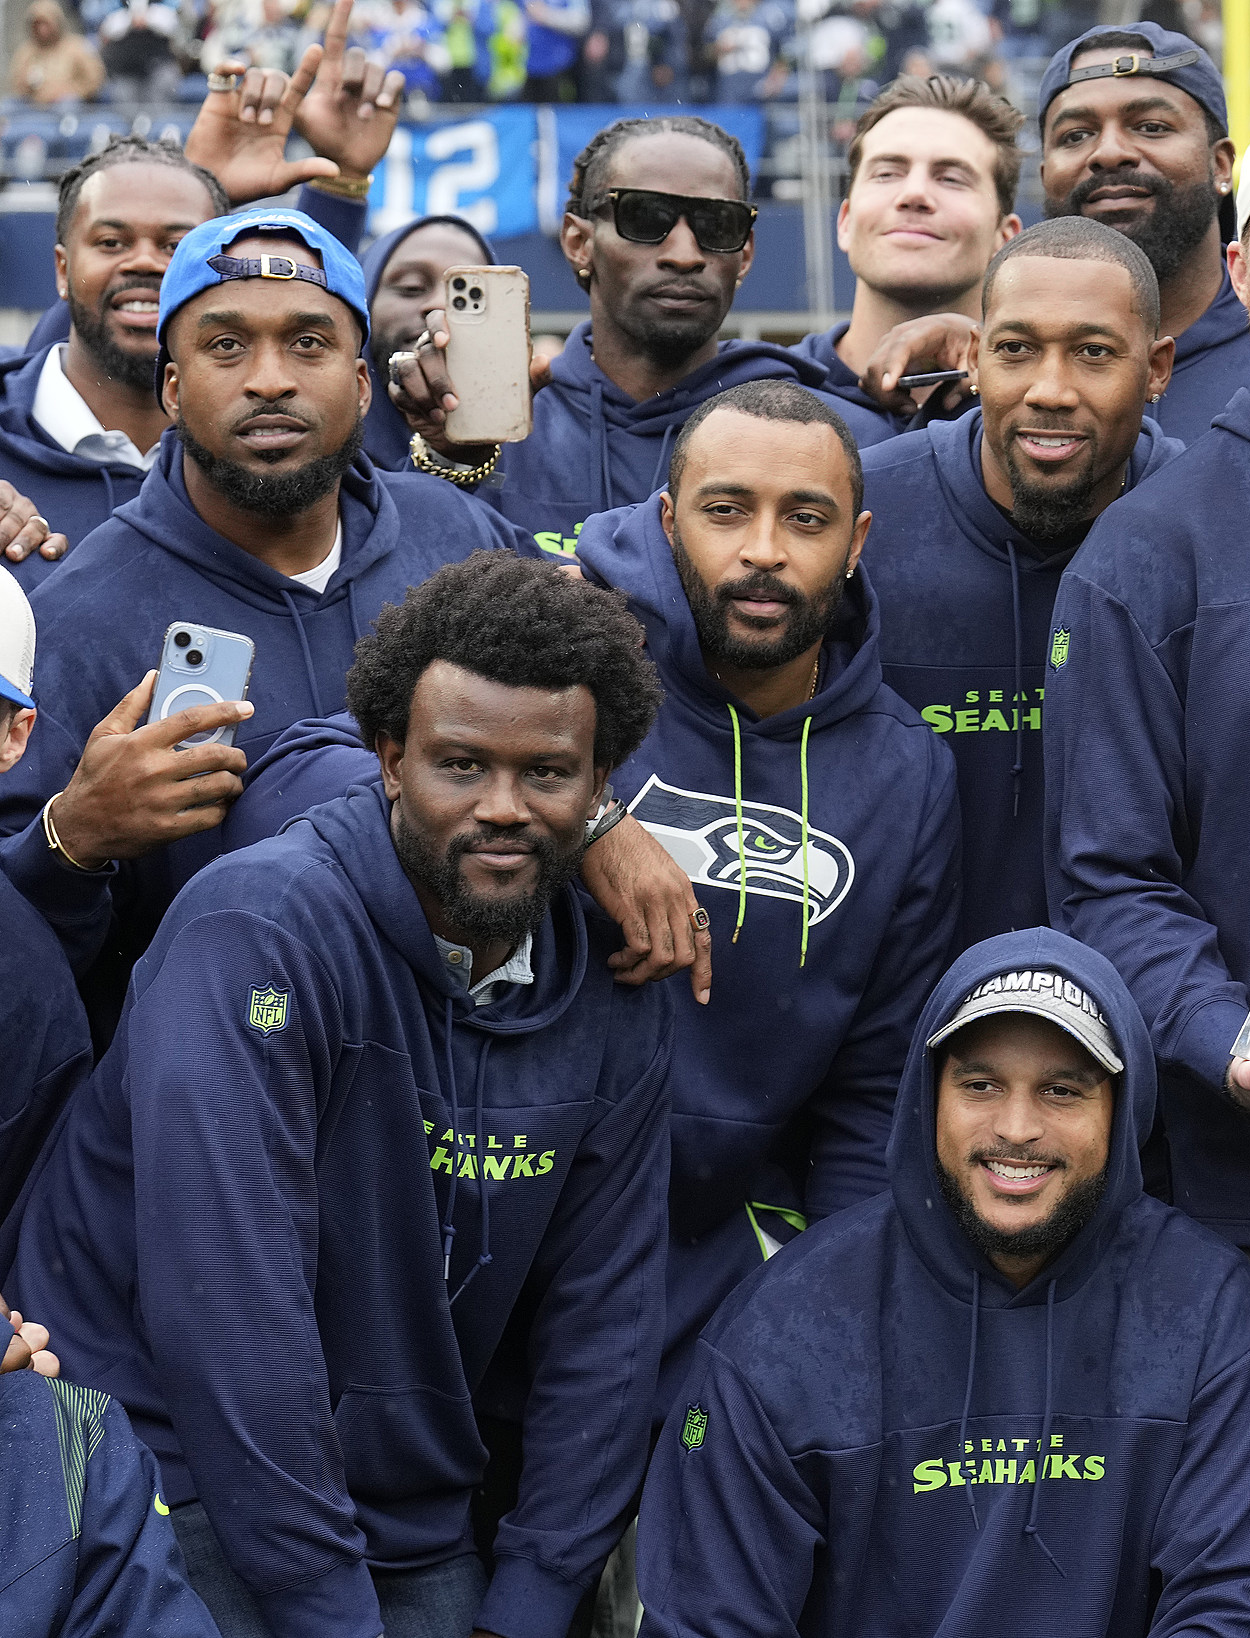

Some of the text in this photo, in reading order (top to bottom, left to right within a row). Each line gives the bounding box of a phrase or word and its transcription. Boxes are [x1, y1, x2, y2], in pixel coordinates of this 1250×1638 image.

[370, 120, 500, 236] 12
[254, 1006, 281, 1025] NFL
[964, 971, 1108, 1027] AMPION
[685, 1424, 702, 1443] NFL
